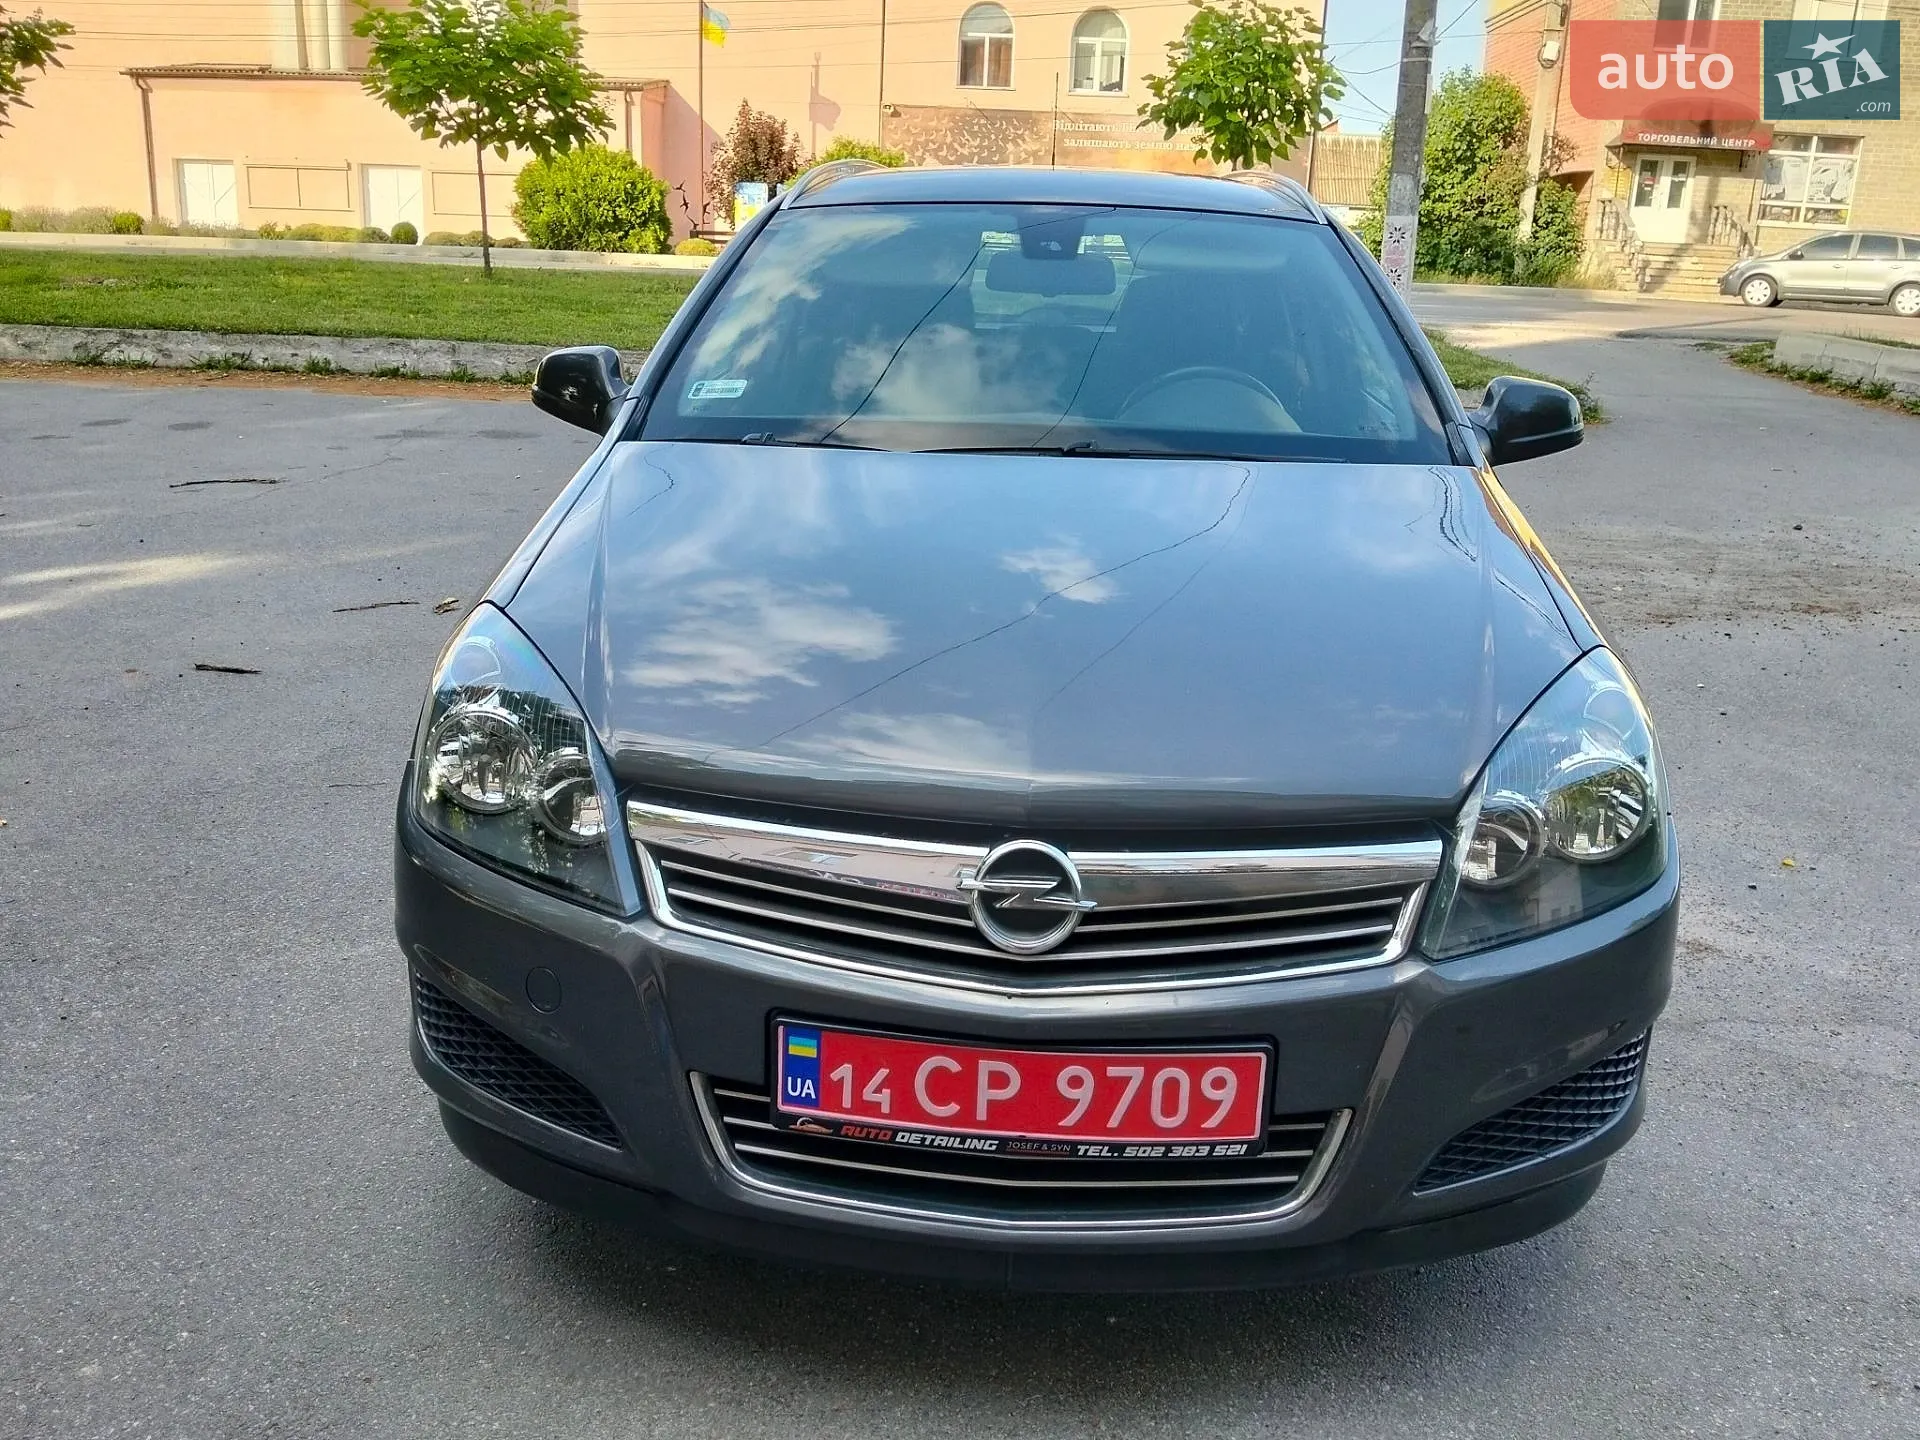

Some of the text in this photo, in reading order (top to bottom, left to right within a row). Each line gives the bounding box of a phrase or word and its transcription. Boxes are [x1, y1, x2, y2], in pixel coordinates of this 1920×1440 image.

[1638, 133, 1756, 148] ТОРГОВЕЛЬНИЙ ЦЕНТР
[787, 1076, 816, 1099] UA
[830, 1055, 1238, 1129] 14 CP 9709
[840, 1125, 999, 1151] AUTO DETAILING
[1050, 1143, 1071, 1152] SYN
[1077, 1144, 1118, 1157] TEL.
[1123, 1146, 1162, 1157] 502
[1168, 1145, 1208, 1157] 383
[1213, 1144, 1248, 1156] 521
